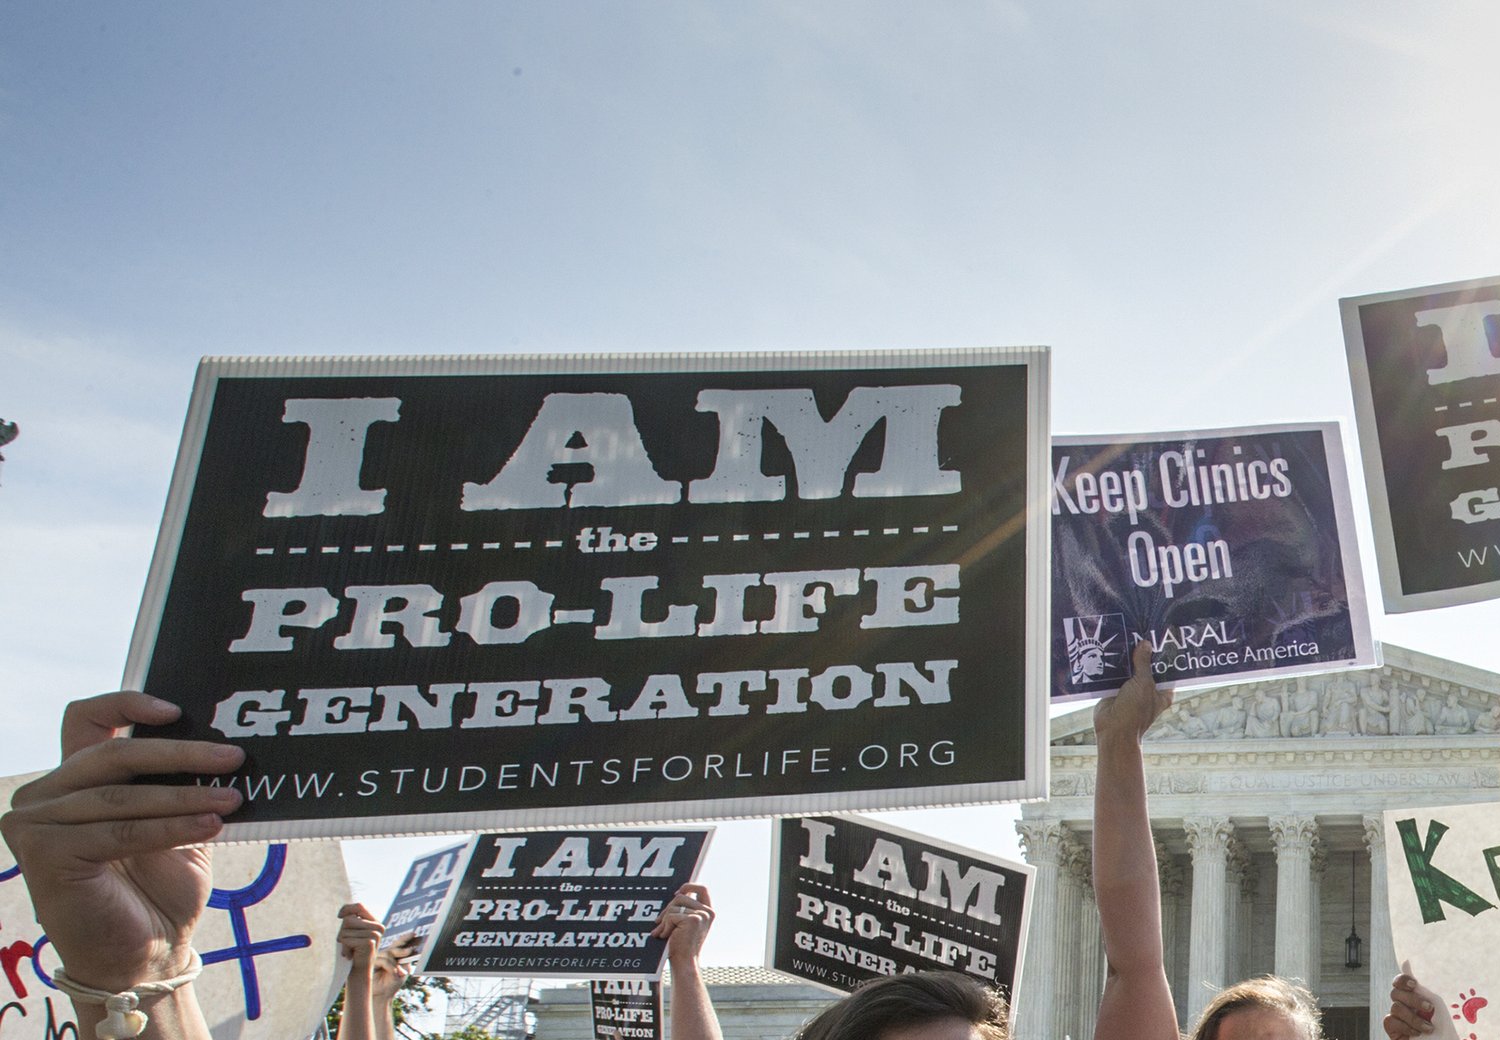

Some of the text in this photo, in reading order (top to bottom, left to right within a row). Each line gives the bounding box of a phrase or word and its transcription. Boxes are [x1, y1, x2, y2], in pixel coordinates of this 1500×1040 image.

[262, 384, 962, 518] I AM
[1051, 446, 1292, 525] Keep Clinics
[576, 524, 659, 555] the
[1127, 531, 1233, 598] Open
[228, 563, 961, 654] PRO-LIFE
[1150, 639, 1320, 676] ro-Choice America
[209, 659, 958, 739] GENERATION
[1219, 772, 1461, 790] EQUAL JUSTICE UNDER LAW
[481, 837, 685, 878] I AM
[800, 818, 1005, 925] I AM
[559, 882, 582, 893] the
[464, 900, 663, 922] PRO-LIFE
[886, 899, 910, 916] the
[453, 931, 651, 948] GENERATION
[796, 893, 997, 980] PRO-LIFE
[445, 956, 641, 968] WWW.STUDENTSFORLIFE.ORG
[595, 1006, 653, 1023] PRO-LIFE
